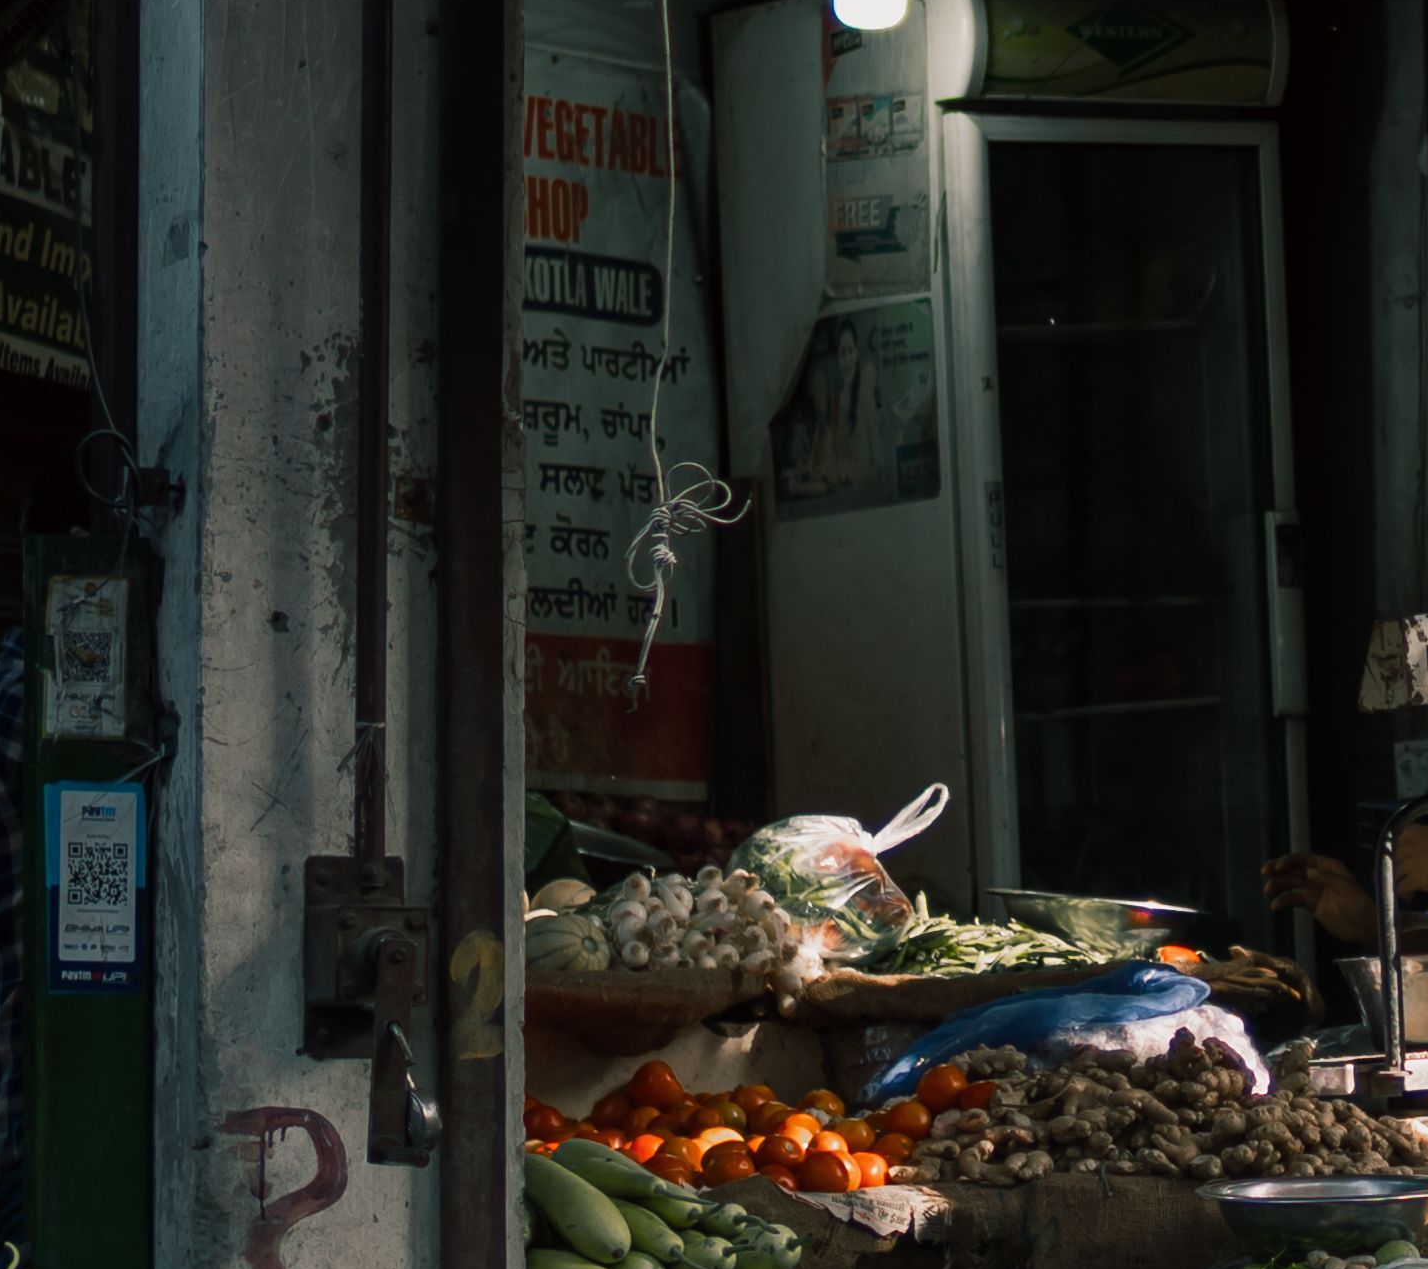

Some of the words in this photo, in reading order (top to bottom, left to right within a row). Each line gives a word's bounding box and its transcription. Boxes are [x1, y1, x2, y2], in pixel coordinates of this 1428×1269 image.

[1077, 25, 1164, 40] WESTERN
[523, 173, 588, 243] HOP
[41, 228, 92, 290] Imp
[594, 266, 652, 317] WALE
[988, 489, 1004, 570] PULL
[527, 578, 617, 622] ਲਦੀਆਂ
